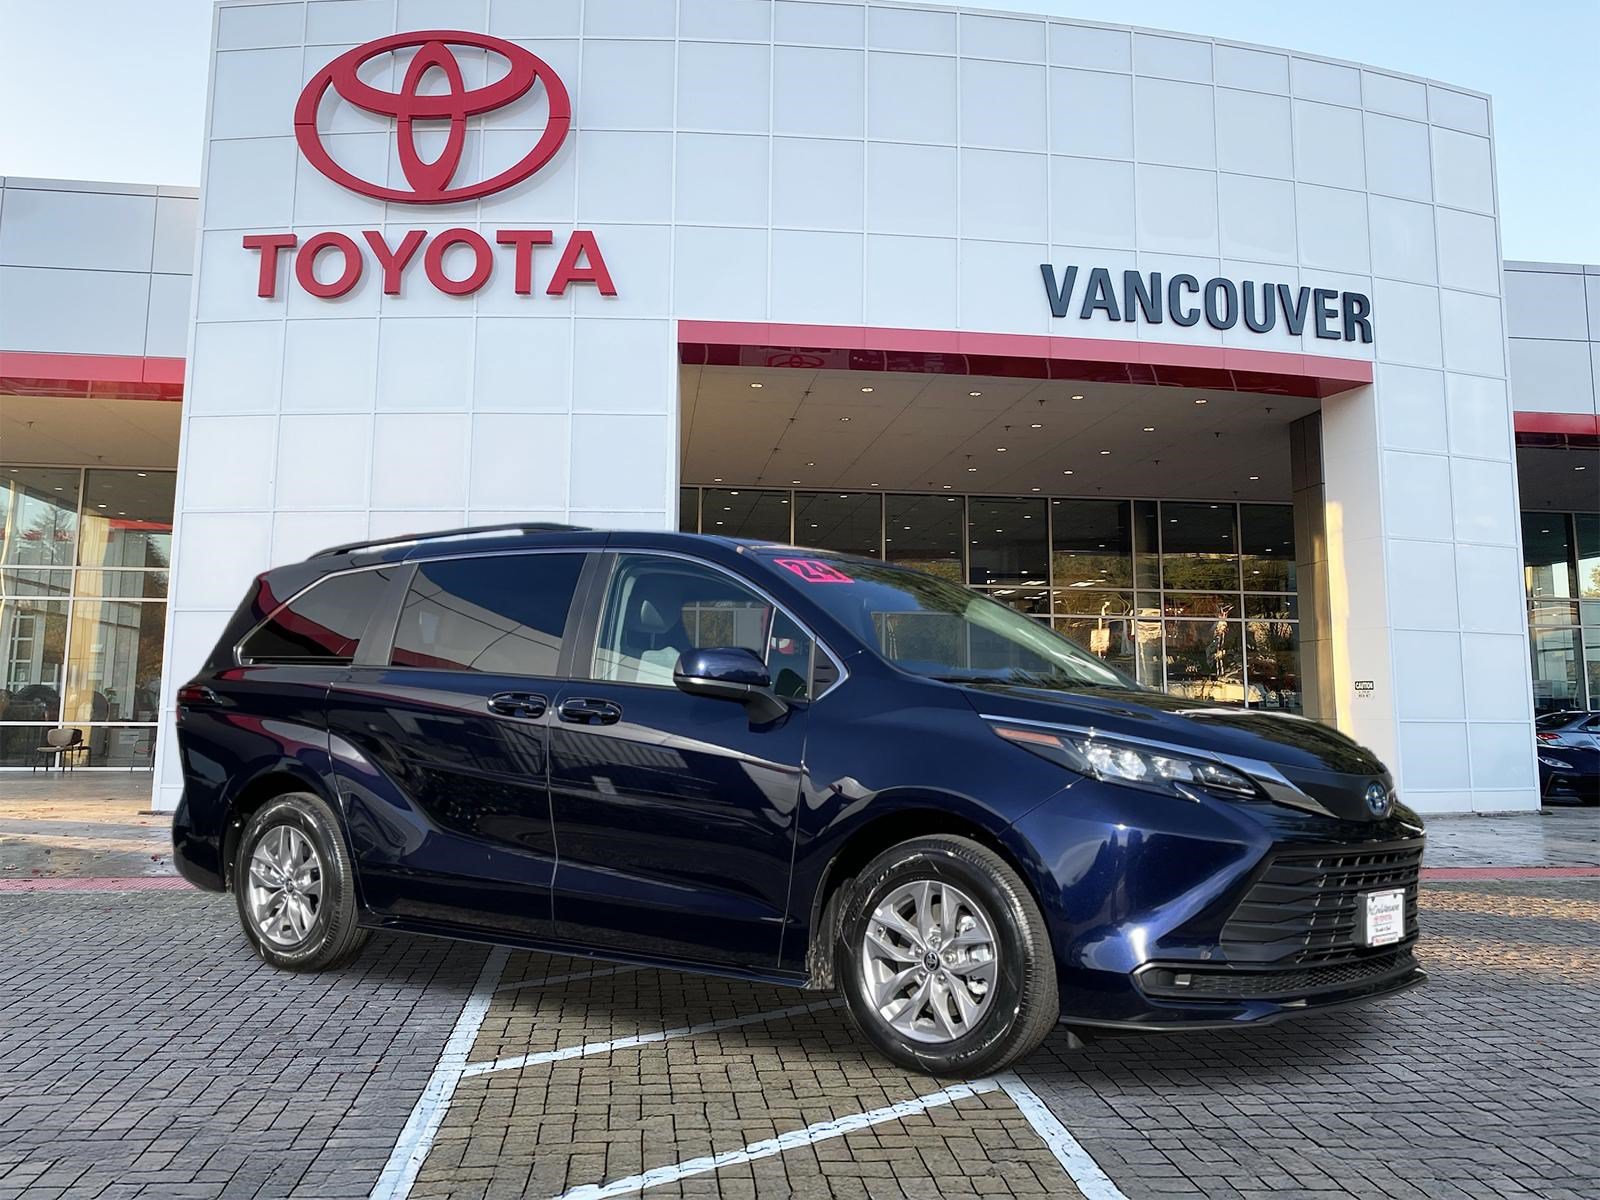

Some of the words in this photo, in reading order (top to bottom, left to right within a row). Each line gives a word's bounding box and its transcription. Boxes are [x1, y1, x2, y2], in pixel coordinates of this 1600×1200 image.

[243, 228, 616, 299] TOYOTA
[1040, 264, 1374, 345] VANCOUVER
[782, 560, 844, 580] 24
